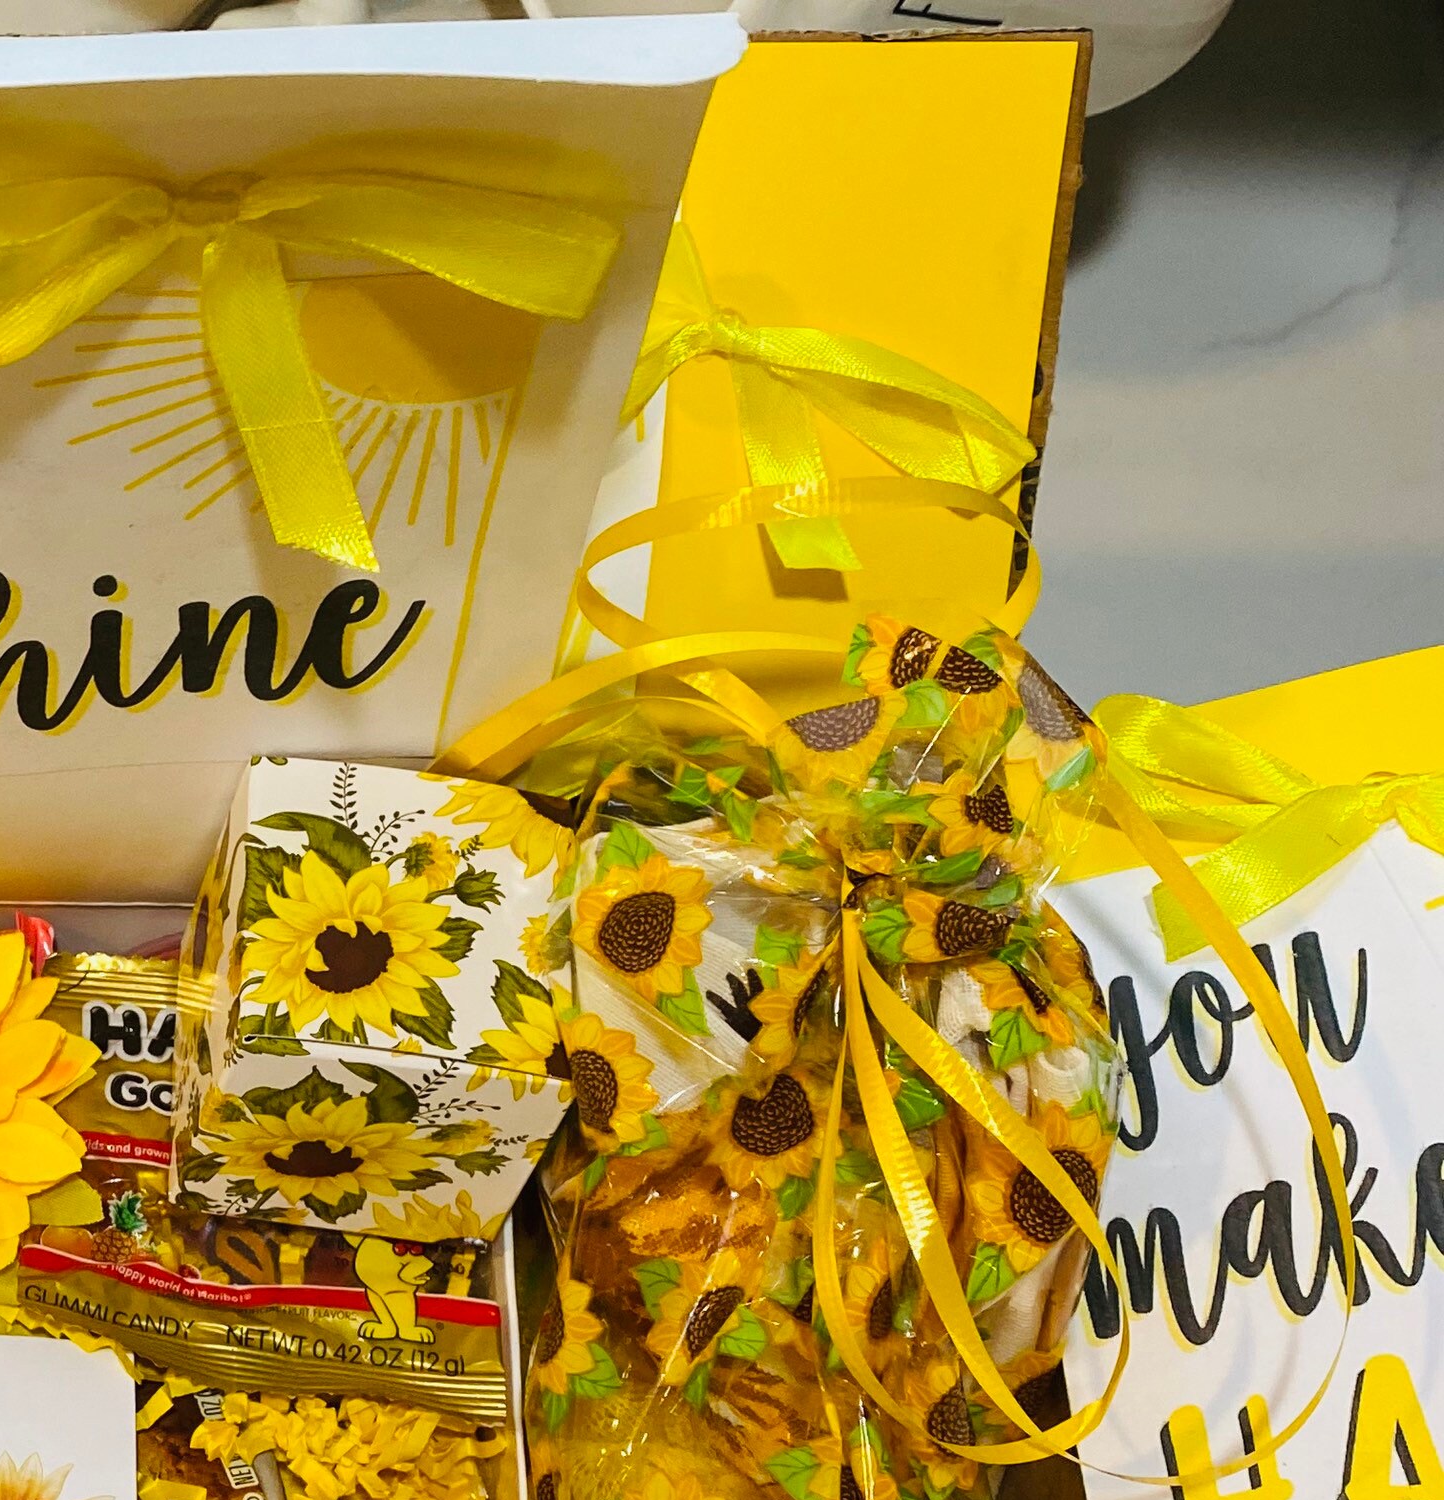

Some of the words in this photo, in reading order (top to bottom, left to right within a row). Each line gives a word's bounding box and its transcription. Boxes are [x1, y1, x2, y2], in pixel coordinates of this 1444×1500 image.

[1109, 931, 1368, 1150] you
[107, 1143, 131, 1154] and
[148, 1276, 181, 1293] world
[183, 1286, 195, 1298] of
[111, 1308, 196, 1340] CANDY
[226, 1325, 270, 1351] NET
[370, 1345, 404, 1369] OZ
